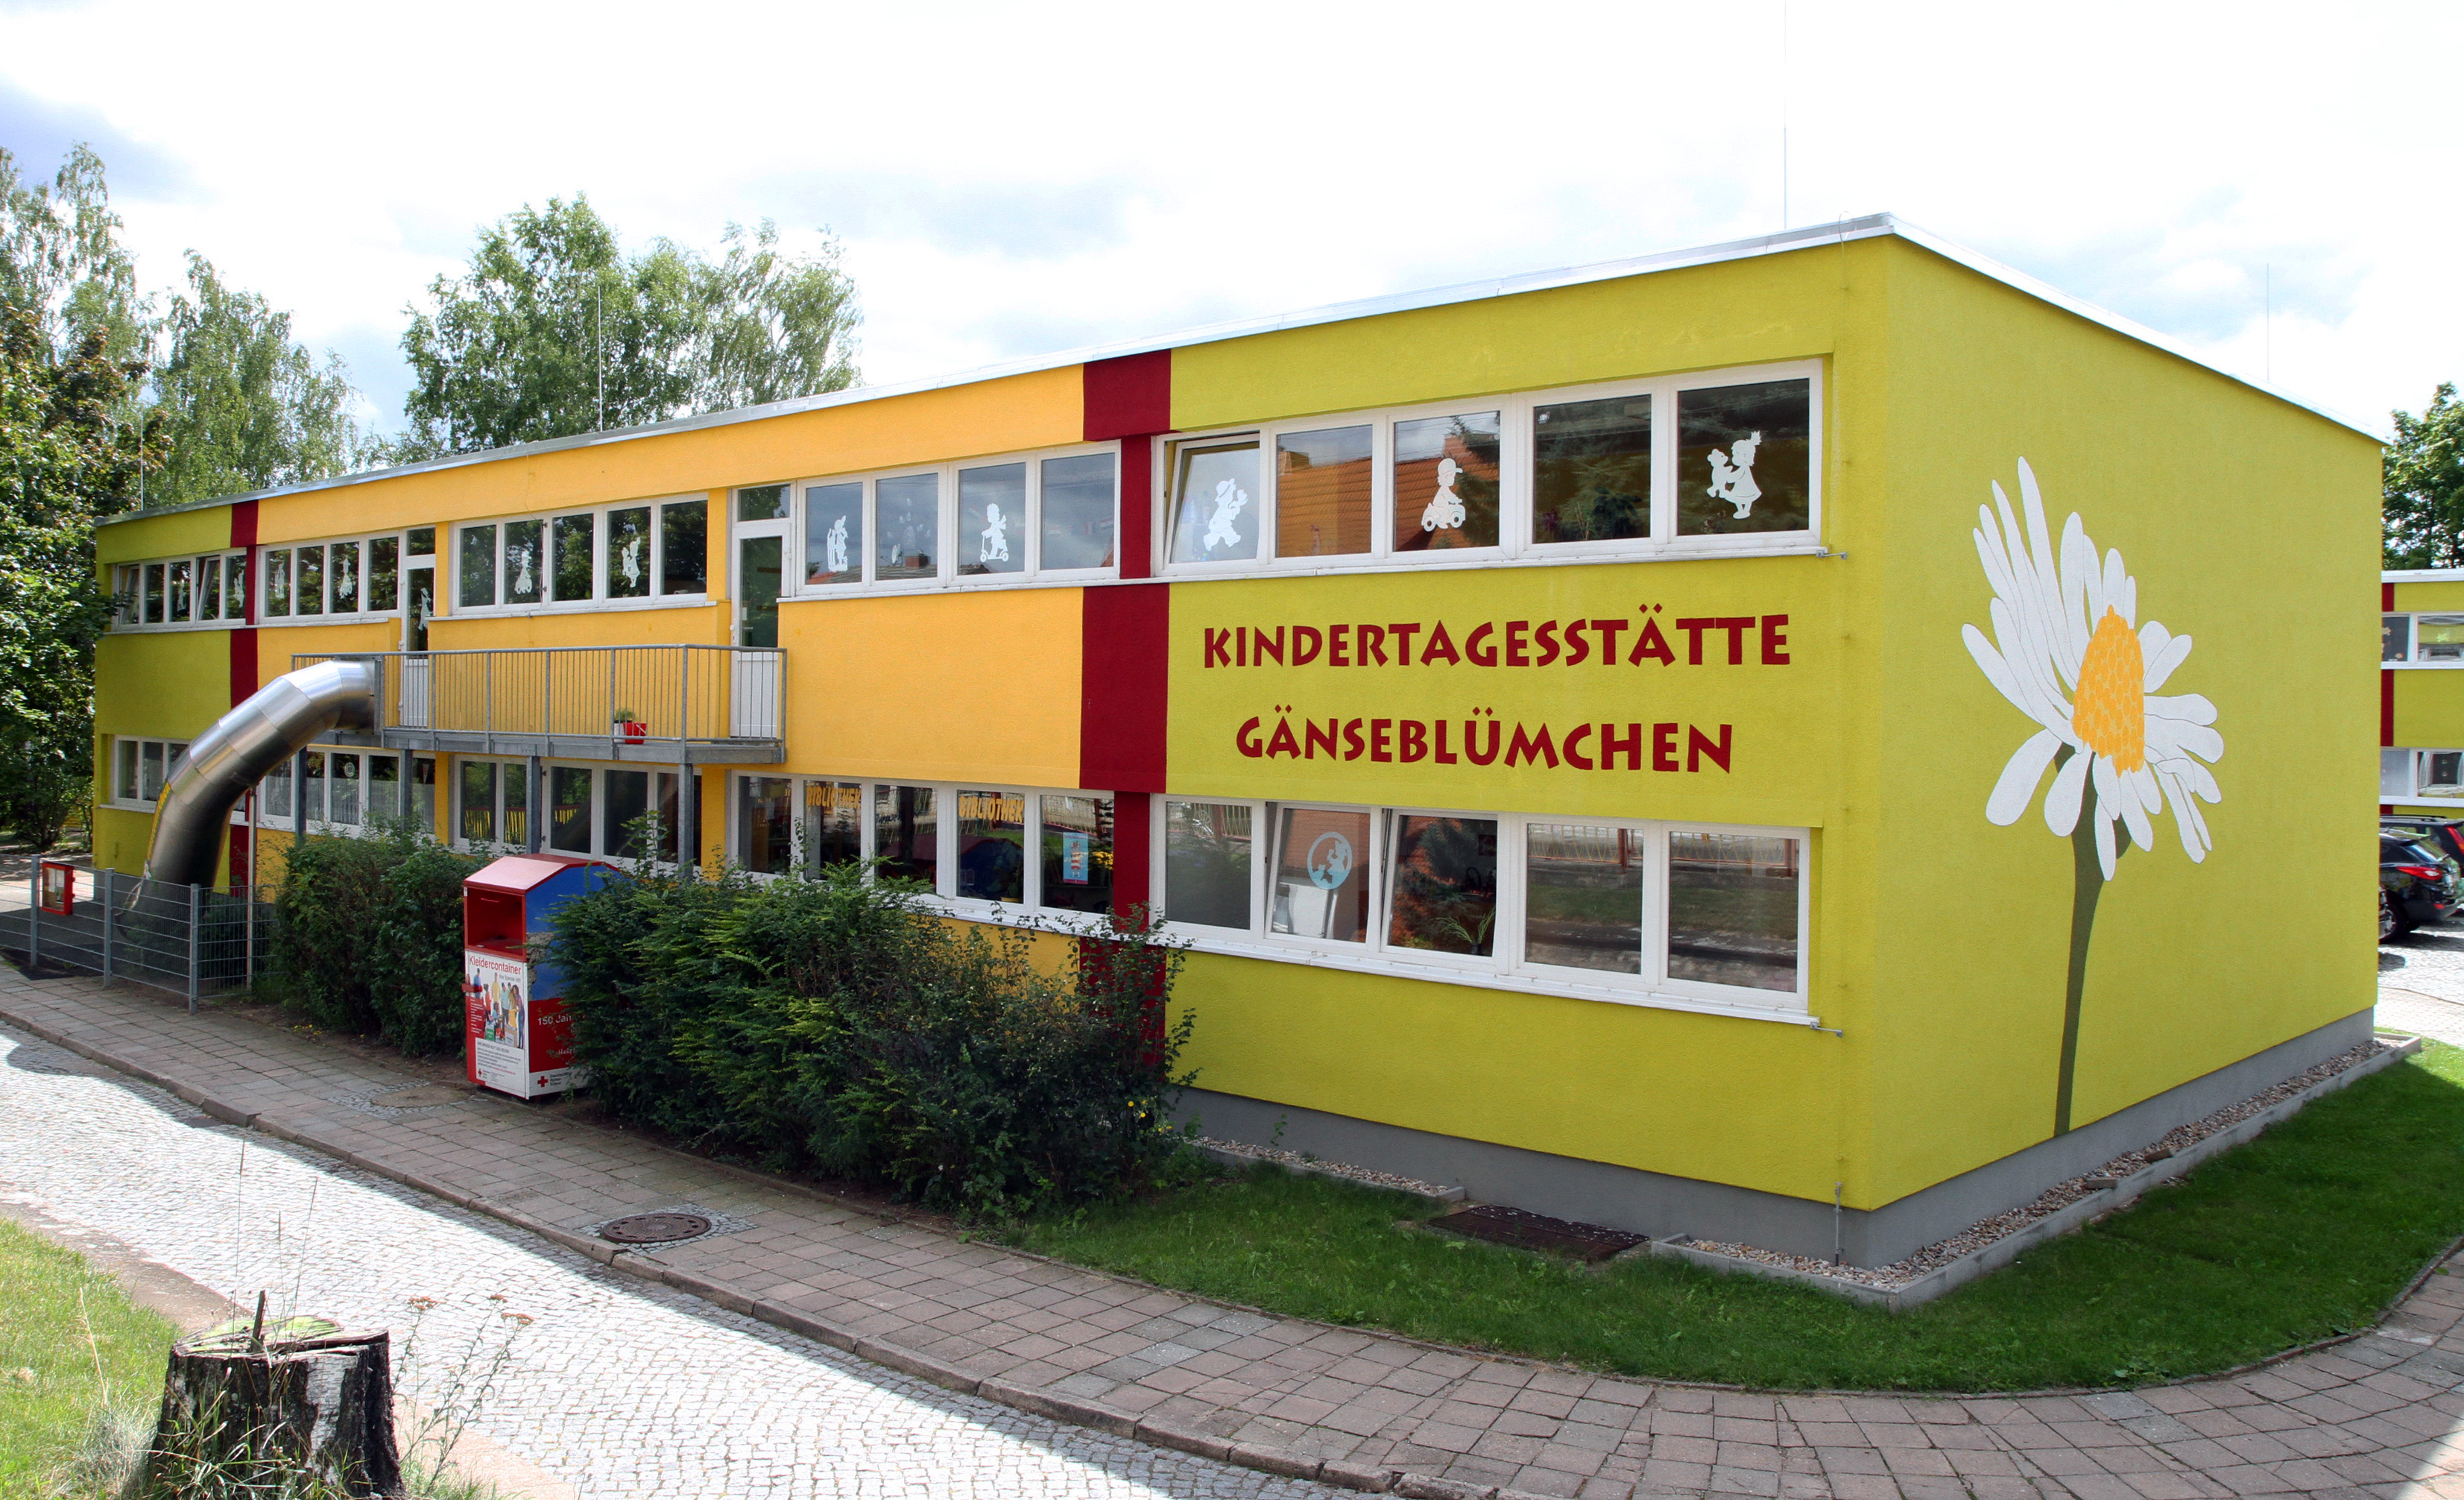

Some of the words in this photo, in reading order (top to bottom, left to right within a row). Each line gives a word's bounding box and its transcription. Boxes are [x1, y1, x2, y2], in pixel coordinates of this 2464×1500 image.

[1204, 603, 1790, 668] KINDERTAGESSTÄTTE
[1236, 704, 1733, 774] GÄNSEBLÜMCHEN
[806, 786, 862, 810] BIBLIOTHEK
[958, 796, 1024, 823] BIBLIOTHEK
[469, 955, 521, 975] Kleidercontainer
[537, 1015, 554, 1026] 150
